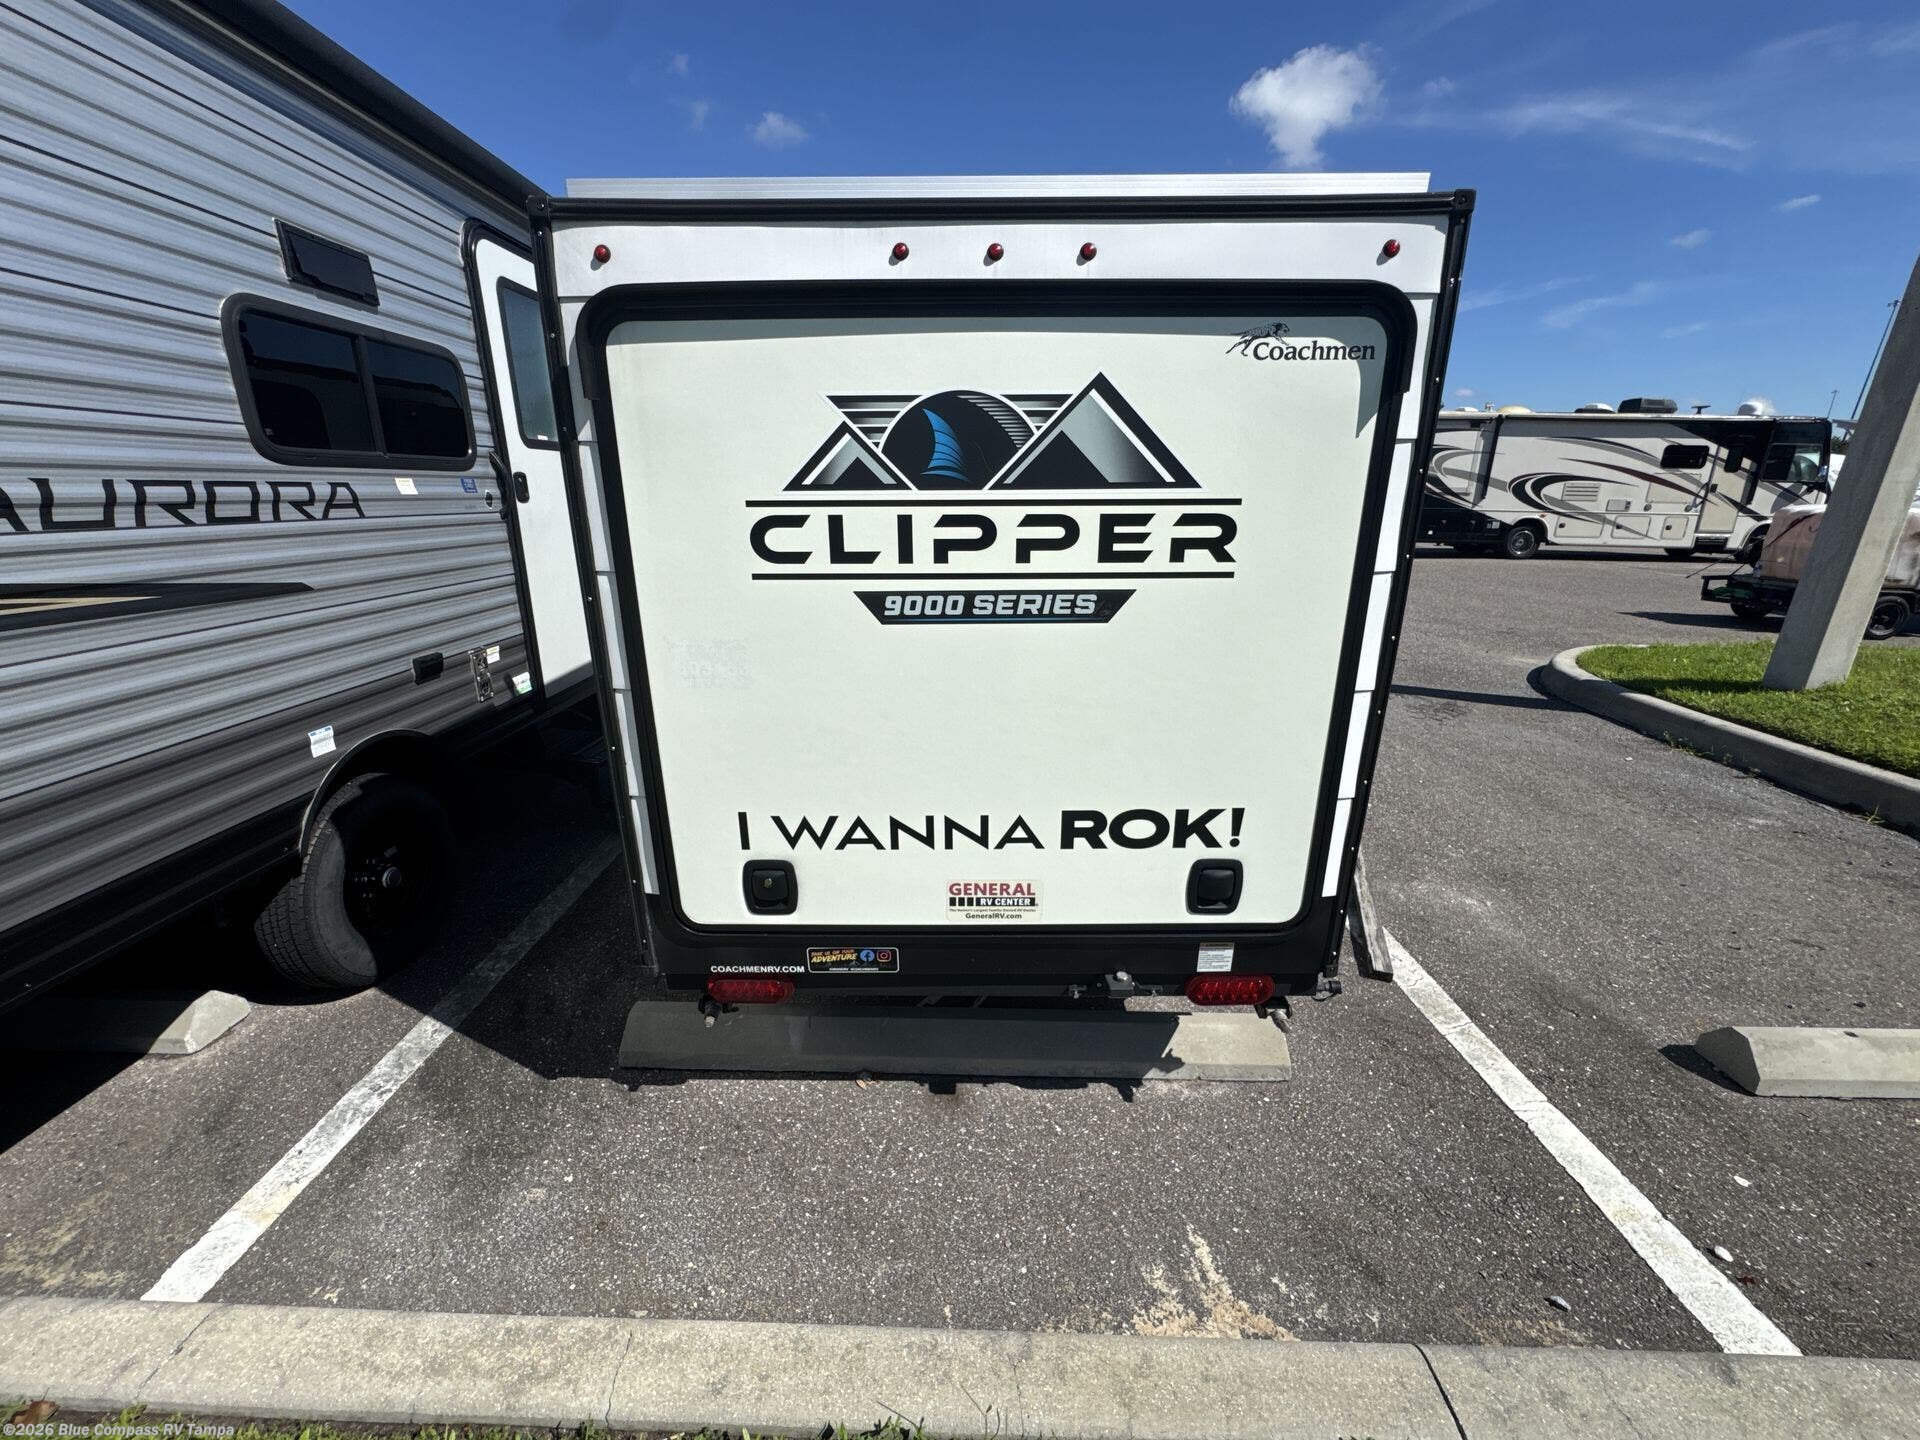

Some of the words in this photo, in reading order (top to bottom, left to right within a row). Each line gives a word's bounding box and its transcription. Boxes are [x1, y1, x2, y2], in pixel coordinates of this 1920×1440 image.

[1253, 340, 1376, 361] Coachmen
[749, 512, 1238, 565] CLIPPER
[883, 595, 966, 617] 9000
[972, 593, 1098, 616] SERIES
[737, 811, 751, 850] I
[770, 814, 1045, 851] WANNA
[1060, 807, 1246, 850] ROK!
[948, 882, 1036, 896] GENERAL
[980, 898, 993, 907] RV
[994, 898, 1031, 907] CENTER
[965, 912, 1022, 920] GeneralRV.com
[811, 952, 858, 963] ADVENTURE
[710, 965, 805, 974] COACHMENRV.COM
